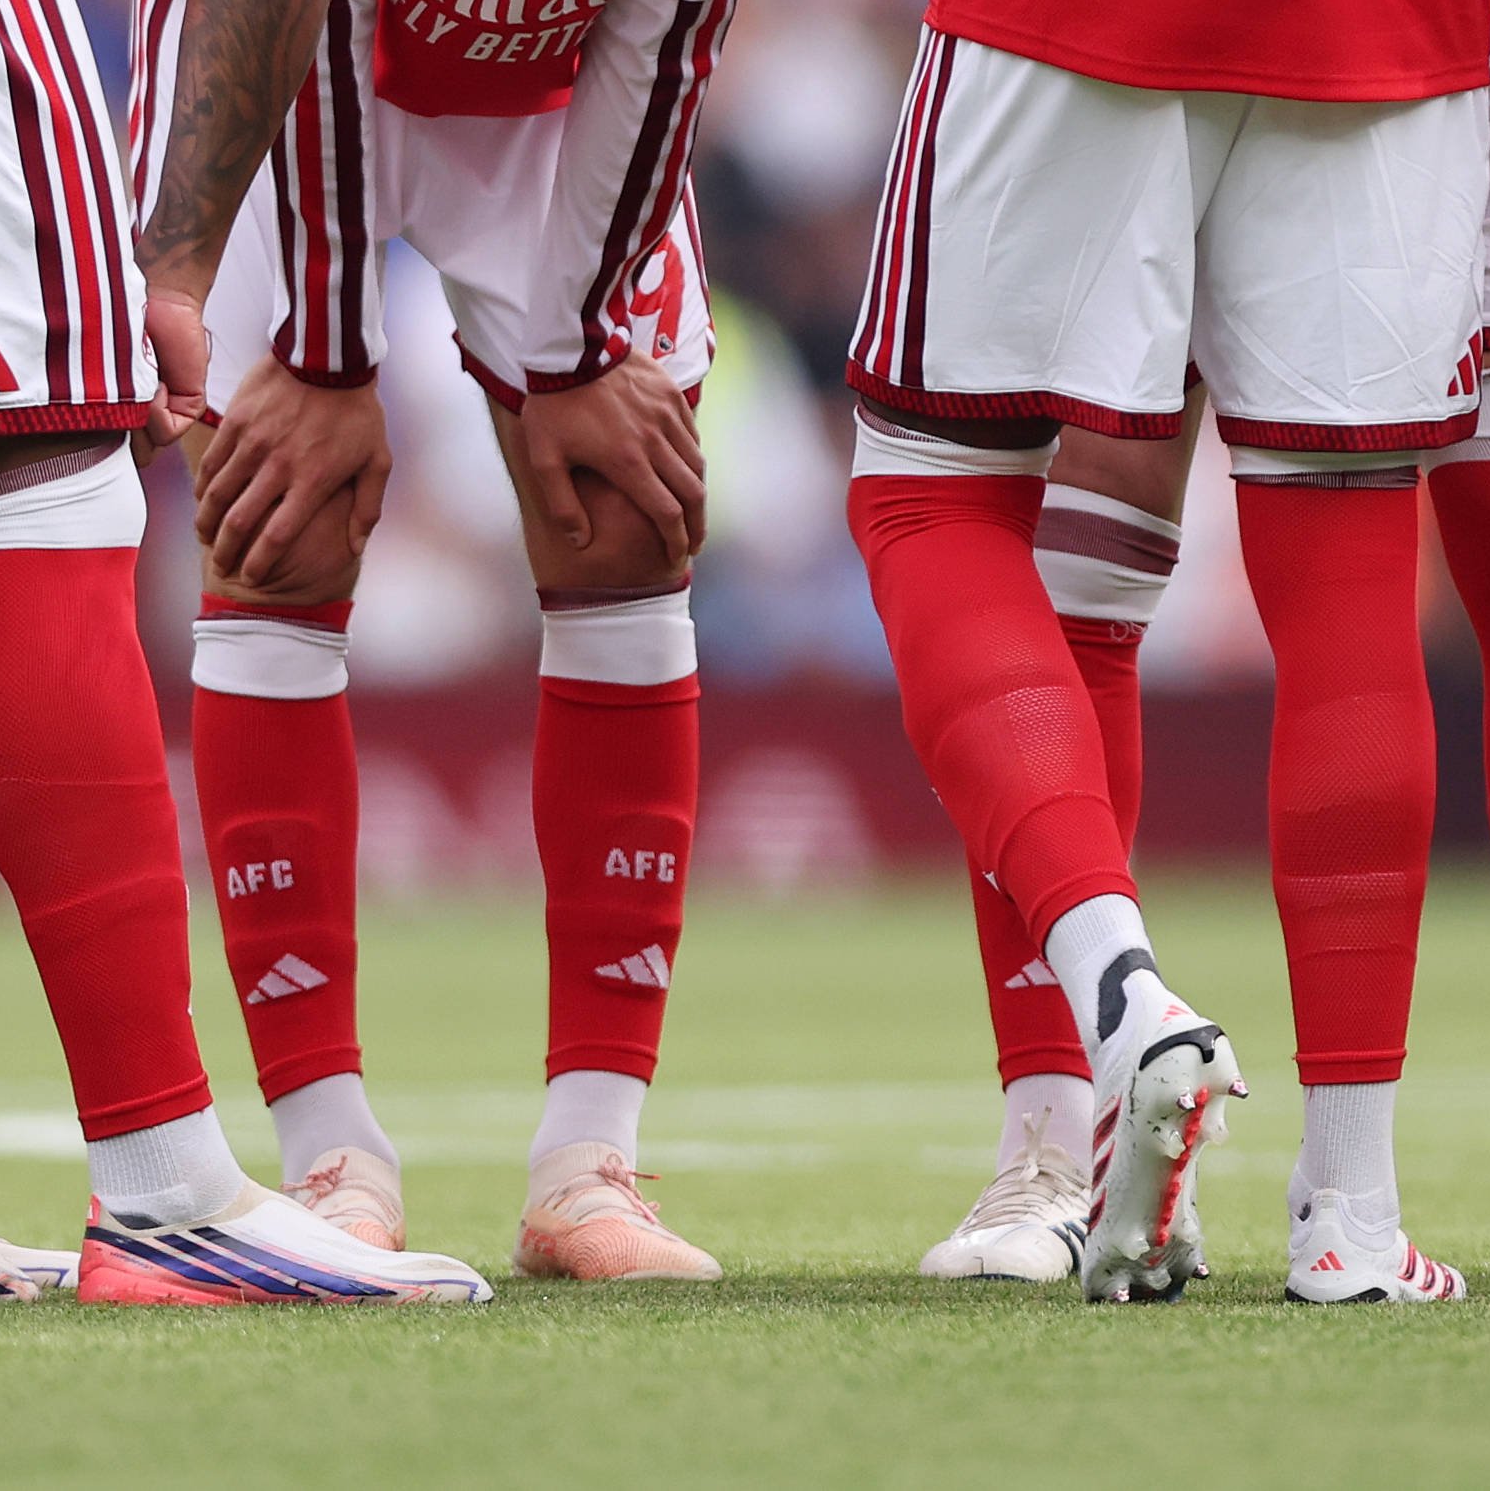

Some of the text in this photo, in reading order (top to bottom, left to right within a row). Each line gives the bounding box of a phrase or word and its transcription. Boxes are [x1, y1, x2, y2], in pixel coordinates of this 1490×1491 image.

[463, 18, 595, 63] BETT
[227, 858, 294, 899] AFC
[605, 847, 676, 883] AFC
